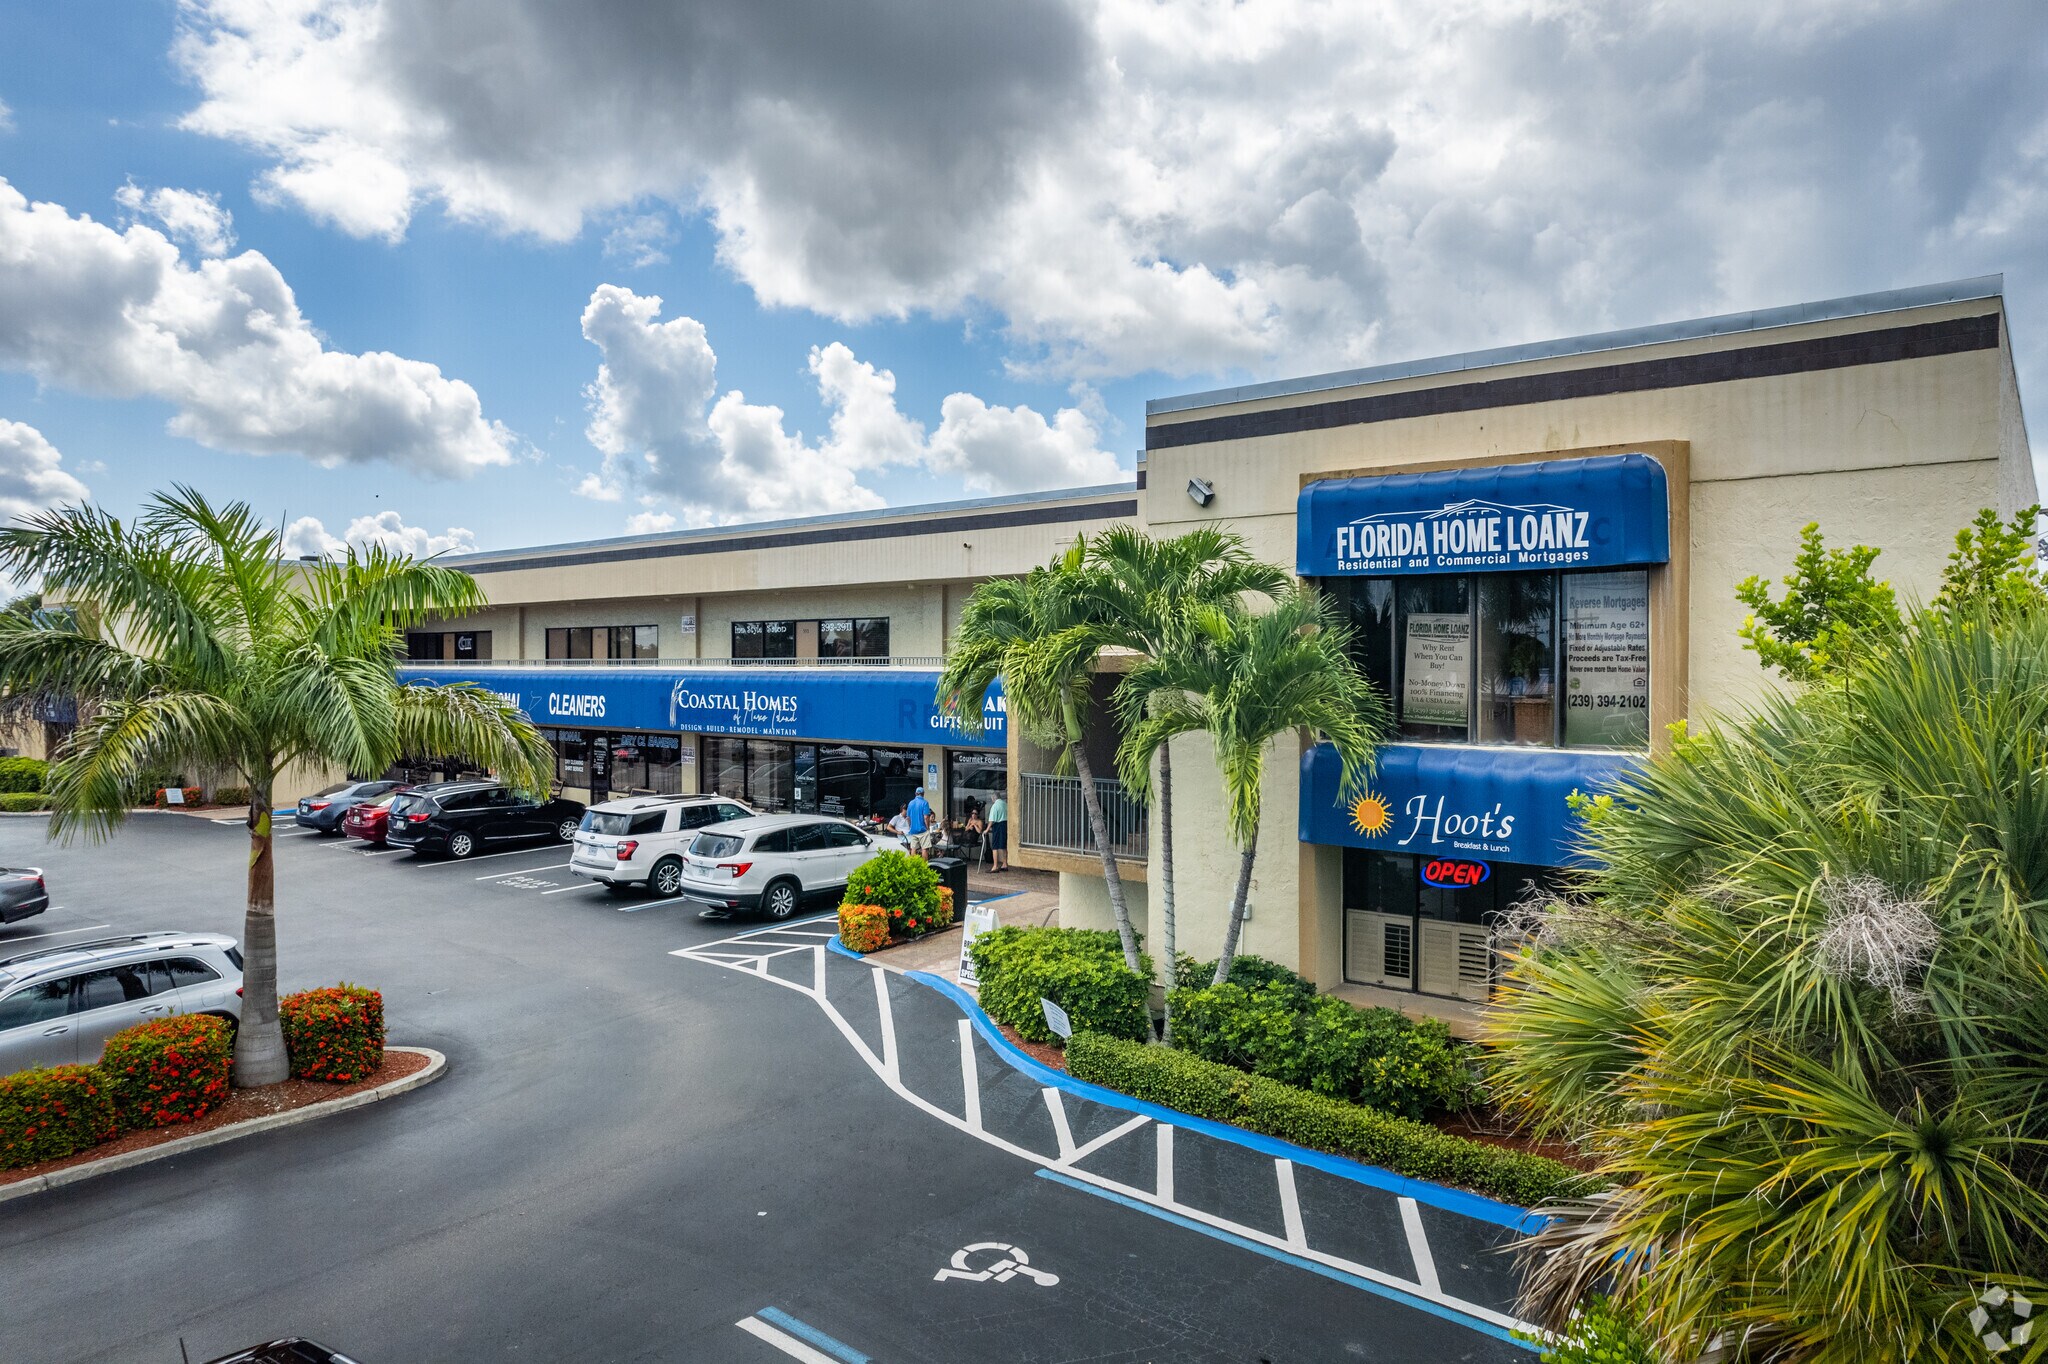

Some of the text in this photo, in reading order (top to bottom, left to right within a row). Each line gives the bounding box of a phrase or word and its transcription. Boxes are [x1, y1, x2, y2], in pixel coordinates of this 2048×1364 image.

[1337, 512, 1589, 559] FLORIDA HOME LOANZ
[1338, 550, 1589, 571] Residential and Commercial Mortgages
[1569, 595, 1646, 611] Reverse Mortgages
[1409, 622, 1470, 635] FLORIDA HOME LOANZ
[1569, 621, 1645, 631] Minimum Age 62+
[1422, 644, 1437, 652] Why
[1569, 644, 1586, 652] Fixed
[1594, 644, 1626, 653] Adjustable
[1627, 644, 1646, 652] Rates
[1414, 652, 1463, 661] When You Can
[1568, 654, 1601, 662] Proceeds
[1615, 654, 1647, 662] Tax-Free
[1430, 662, 1445, 671] Buy!
[1569, 665, 1583, 673] Never
[1618, 665, 1632, 673] Home
[1409, 679, 1444, 688] No-Money
[1429, 689, 1464, 699] Financing
[549, 692, 606, 718] CLEANERS
[1567, 694, 1646, 711] (239) 394-2102
[680, 723, 797, 736] DESIGN BUILD REMODEL MAINTAIN
[880, 749, 919, 760] Remodeling
[958, 755, 1002, 765] Gourmet Foods
[1398, 795, 1516, 845] Hoot's
[1453, 841, 1481, 850] Breakfast
[1490, 844, 1510, 852] Lunch
[1426, 861, 1483, 885] OPEN
